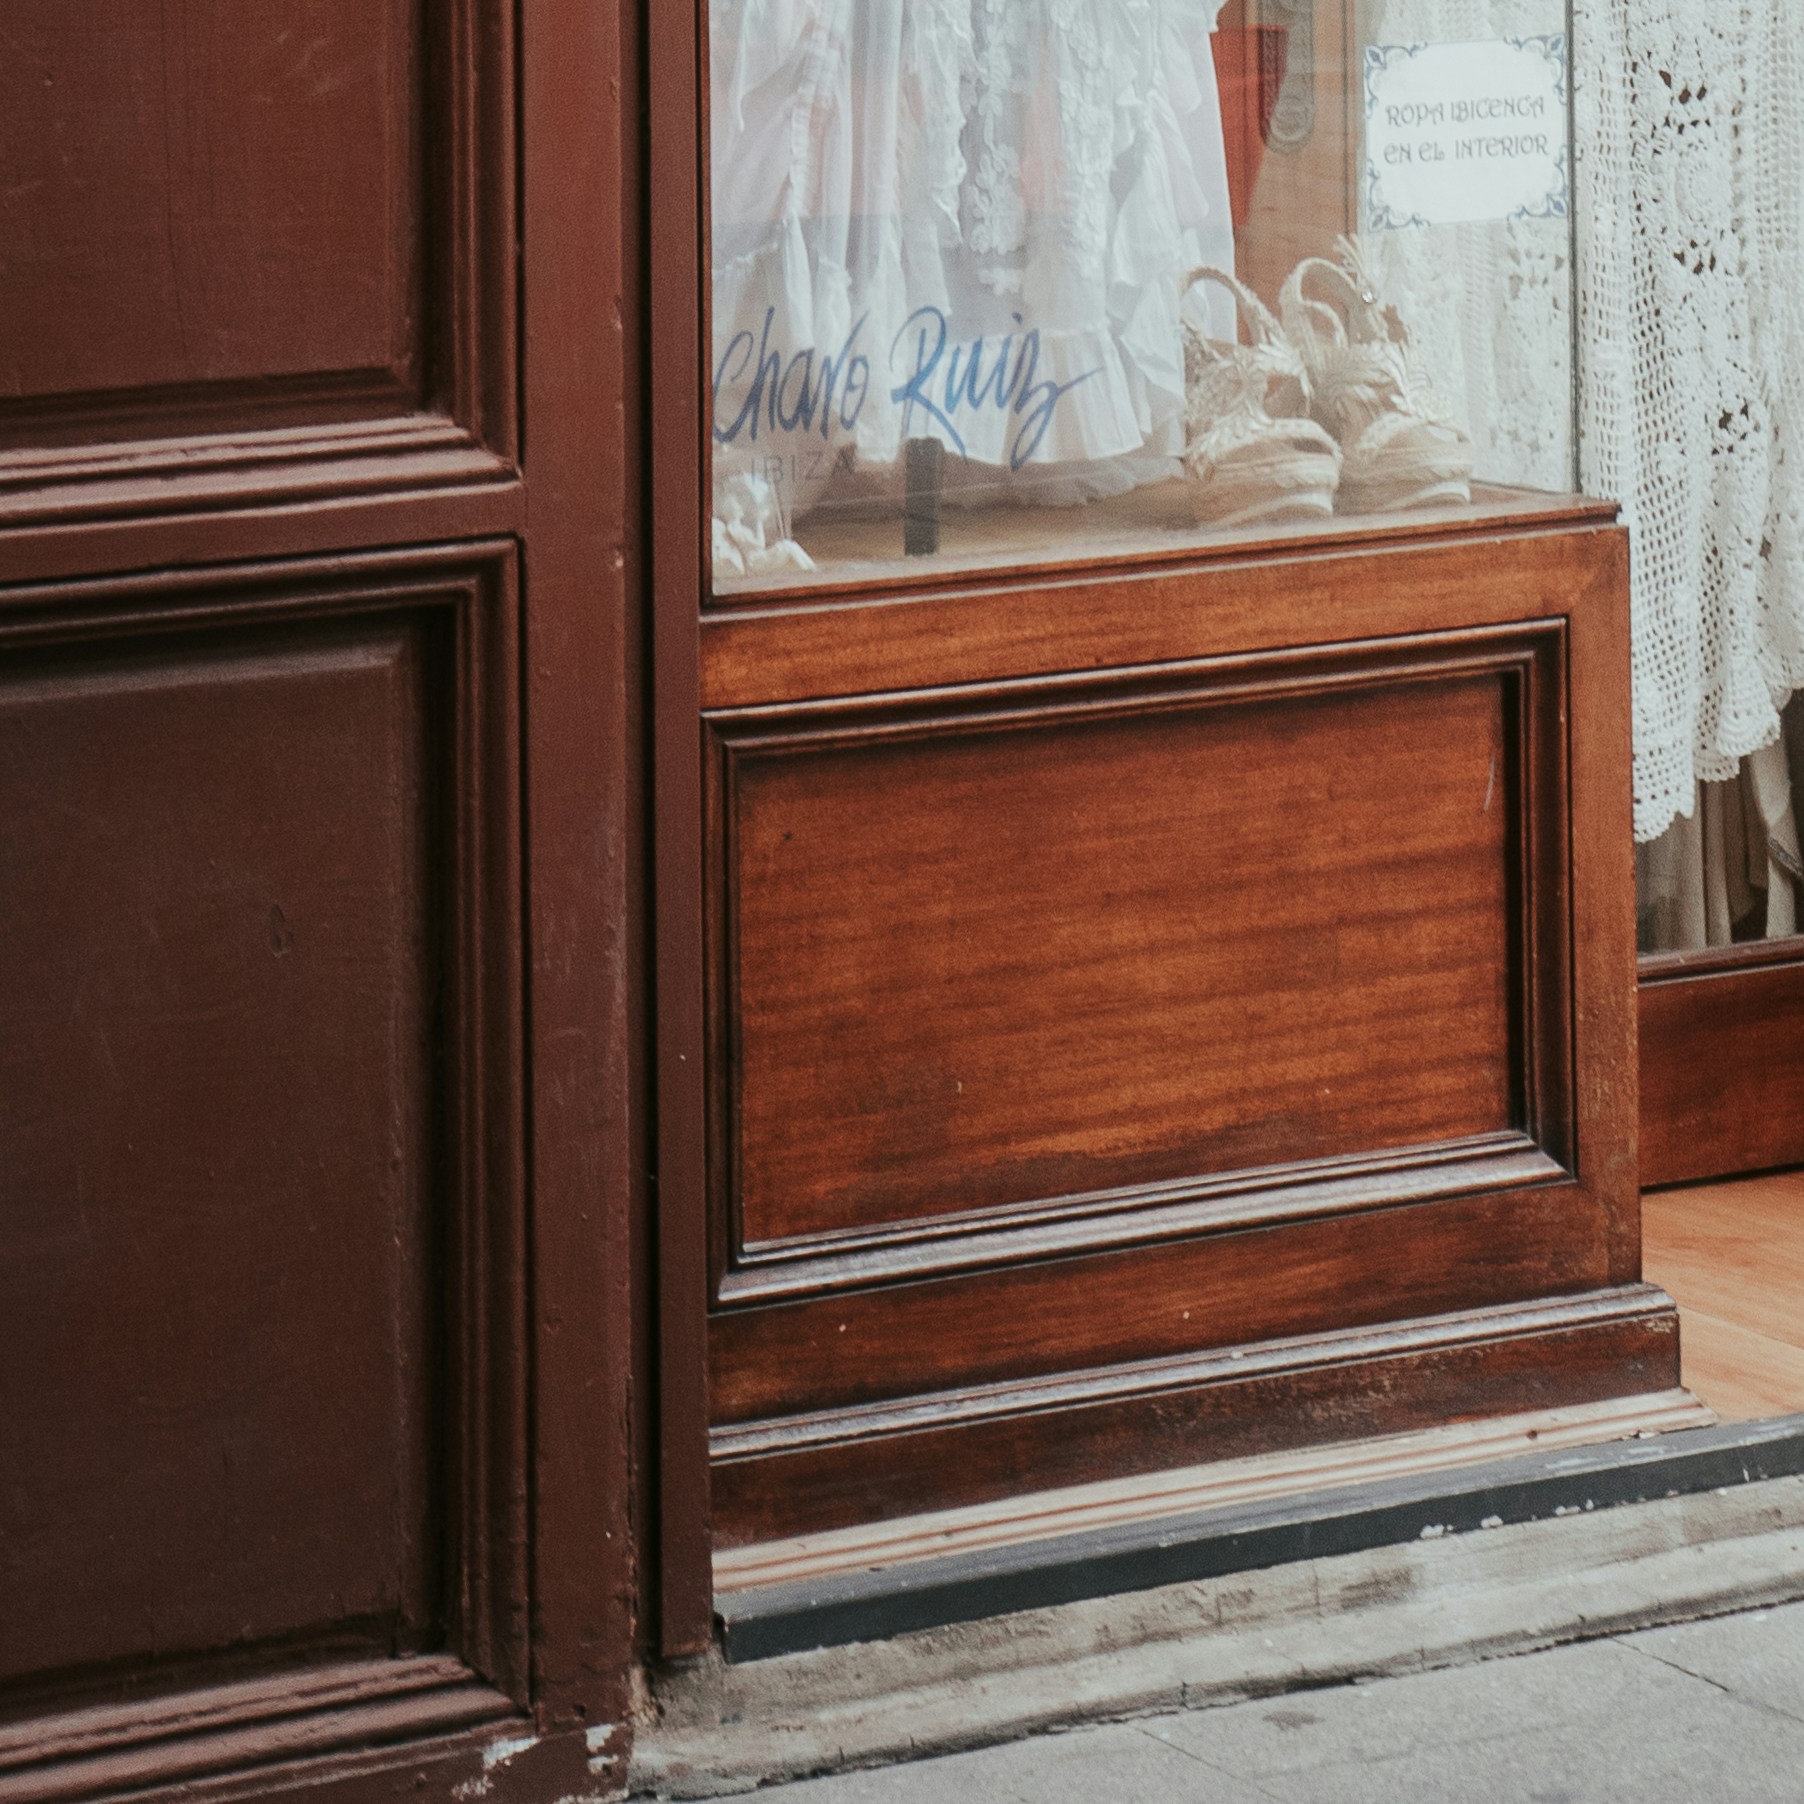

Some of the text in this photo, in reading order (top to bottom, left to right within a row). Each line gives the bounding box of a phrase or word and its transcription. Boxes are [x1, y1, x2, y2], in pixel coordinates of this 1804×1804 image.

[1385, 94, 1545, 127] ROPA IBICENCA
[1384, 133, 1550, 165] EN EL INTERIOR
[712, 305, 1105, 471] Charo Ruiz
[750, 445, 856, 485] IBIZA
